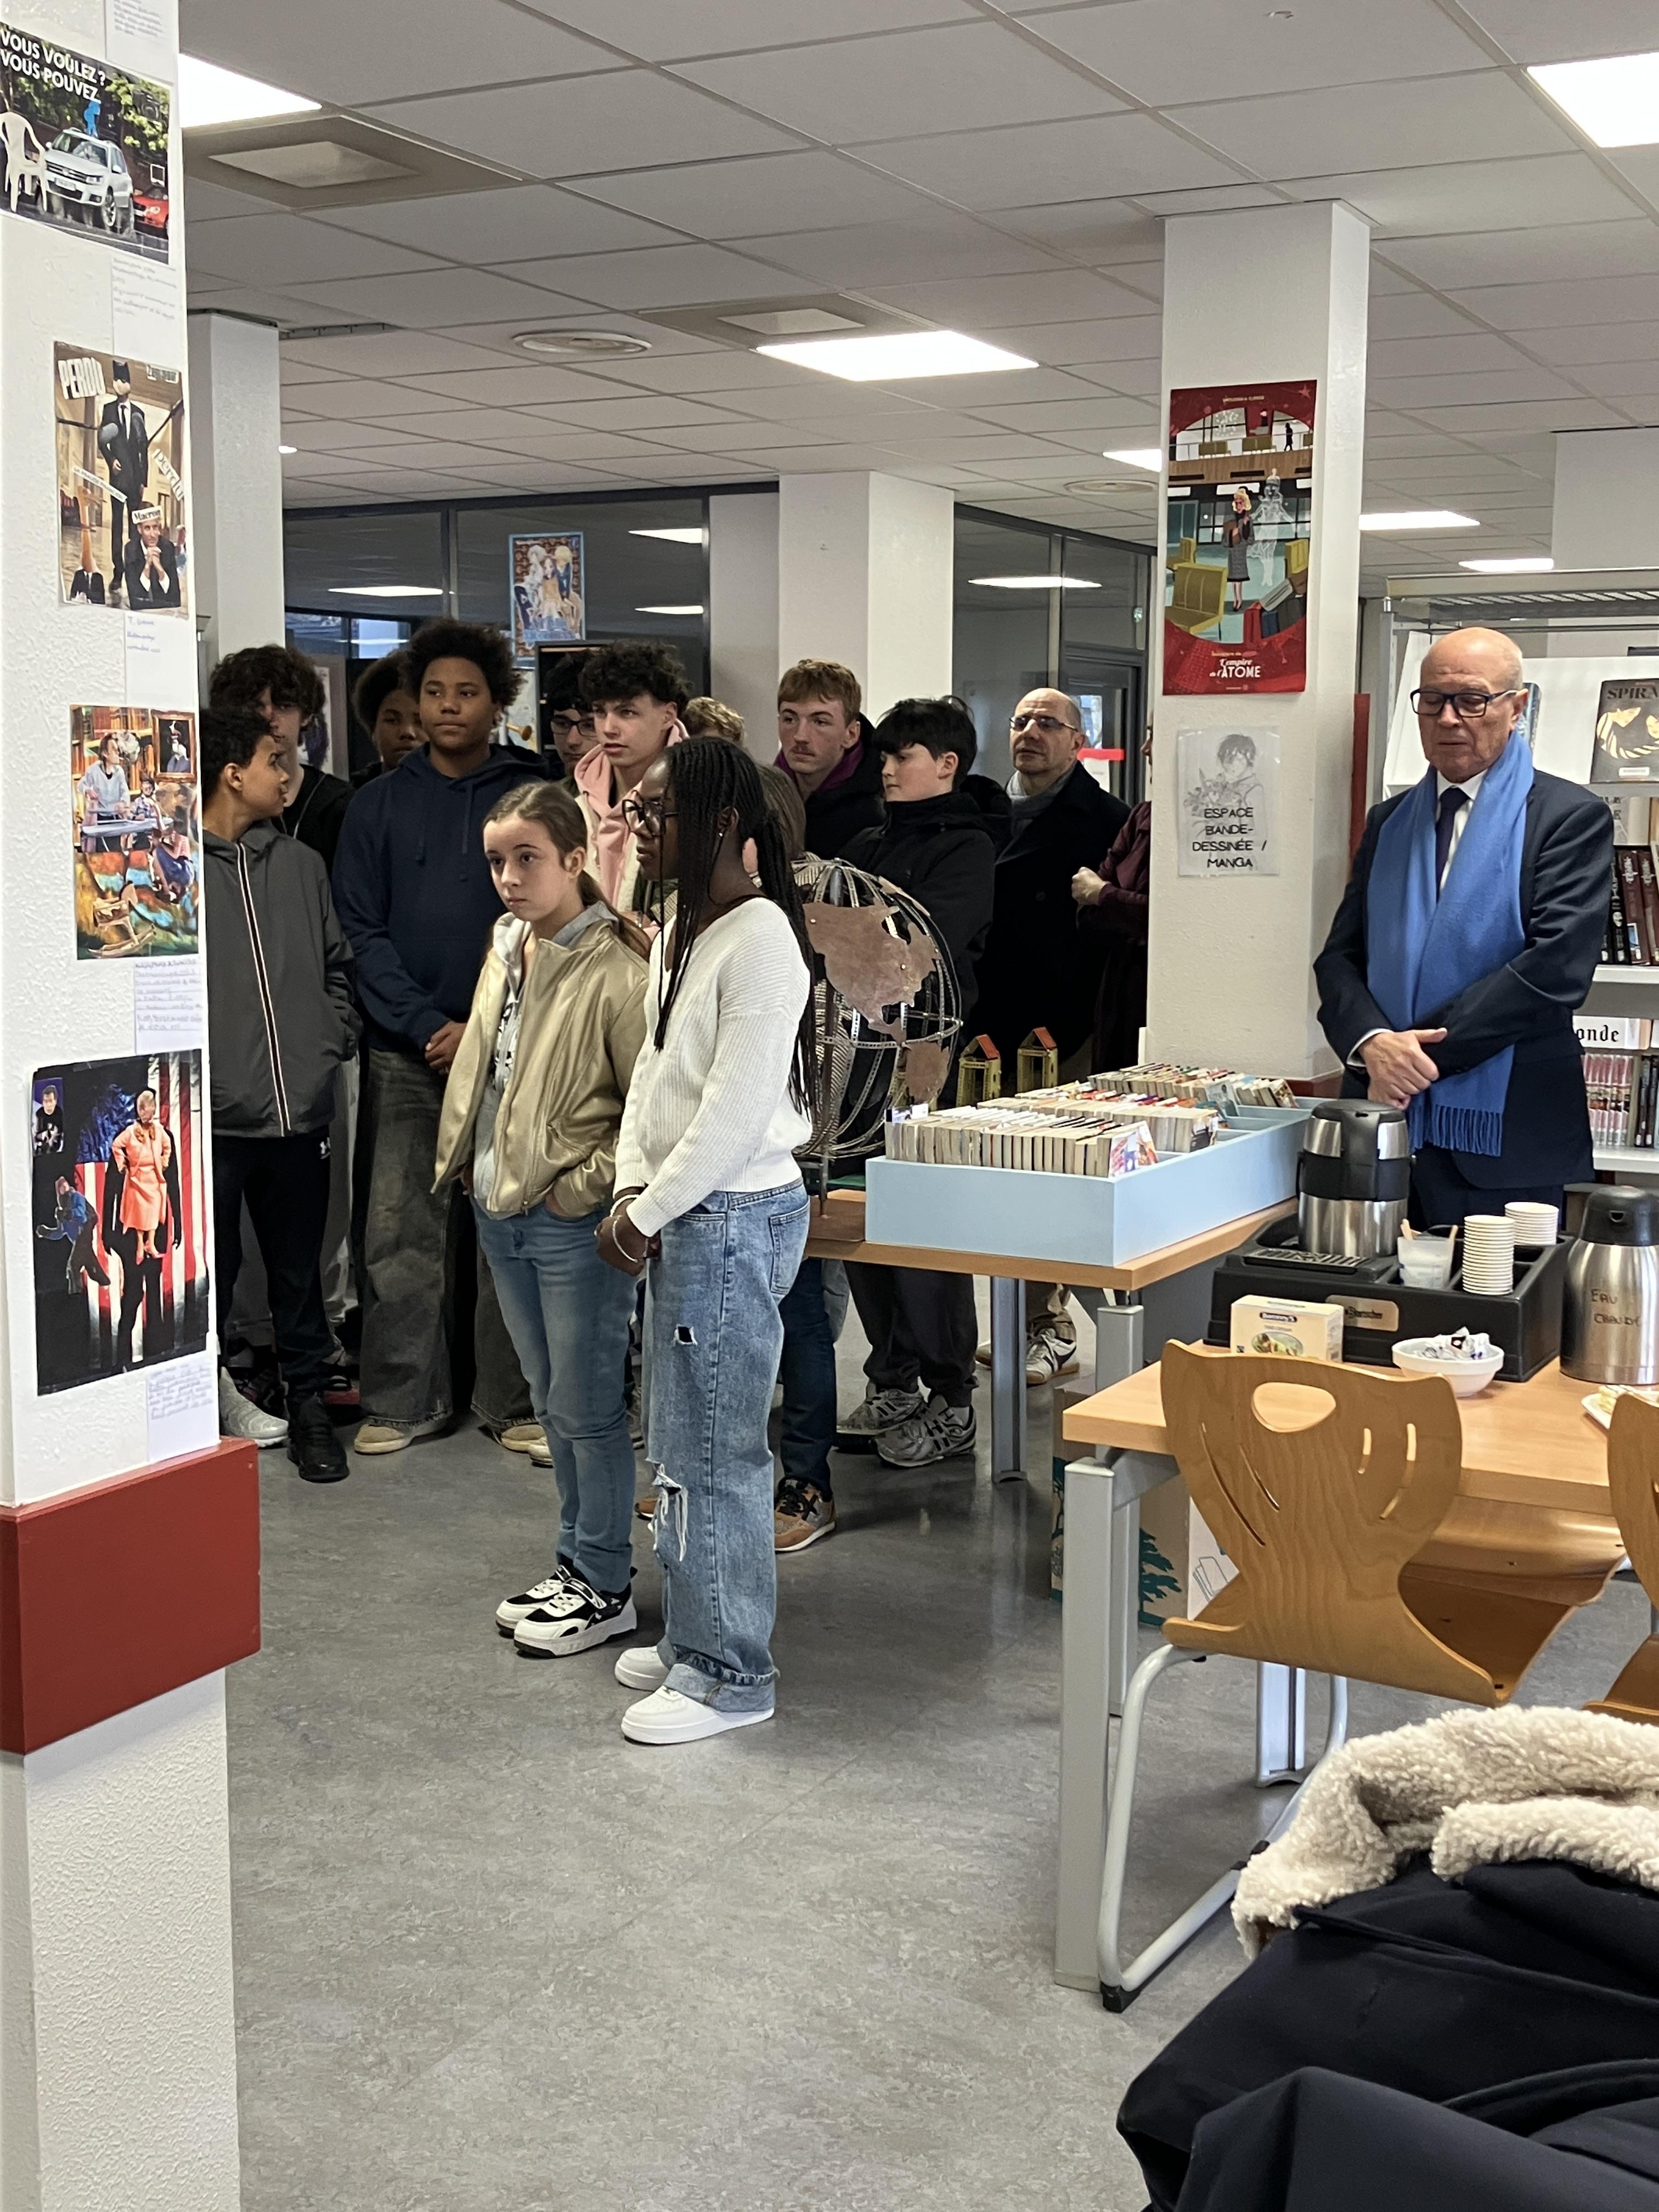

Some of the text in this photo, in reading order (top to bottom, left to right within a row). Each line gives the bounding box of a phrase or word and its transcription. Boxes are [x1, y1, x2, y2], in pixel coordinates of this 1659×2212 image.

[0, 29, 40, 59] VOUS
[0, 48, 41, 80] VOUS
[58, 357, 106, 399] PERDU
[154, 450, 184, 498] perdu
[134, 509, 161, 521] Macron
[1204, 808, 1254, 819] ESPACE
[1205, 825, 1254, 835] BANDE-
[1193, 838, 1254, 851] DESSINÉE
[1207, 857, 1253, 868] MANGA
[1576, 1024, 1620, 1042] onde
[1591, 1289, 1618, 1304] EAU
